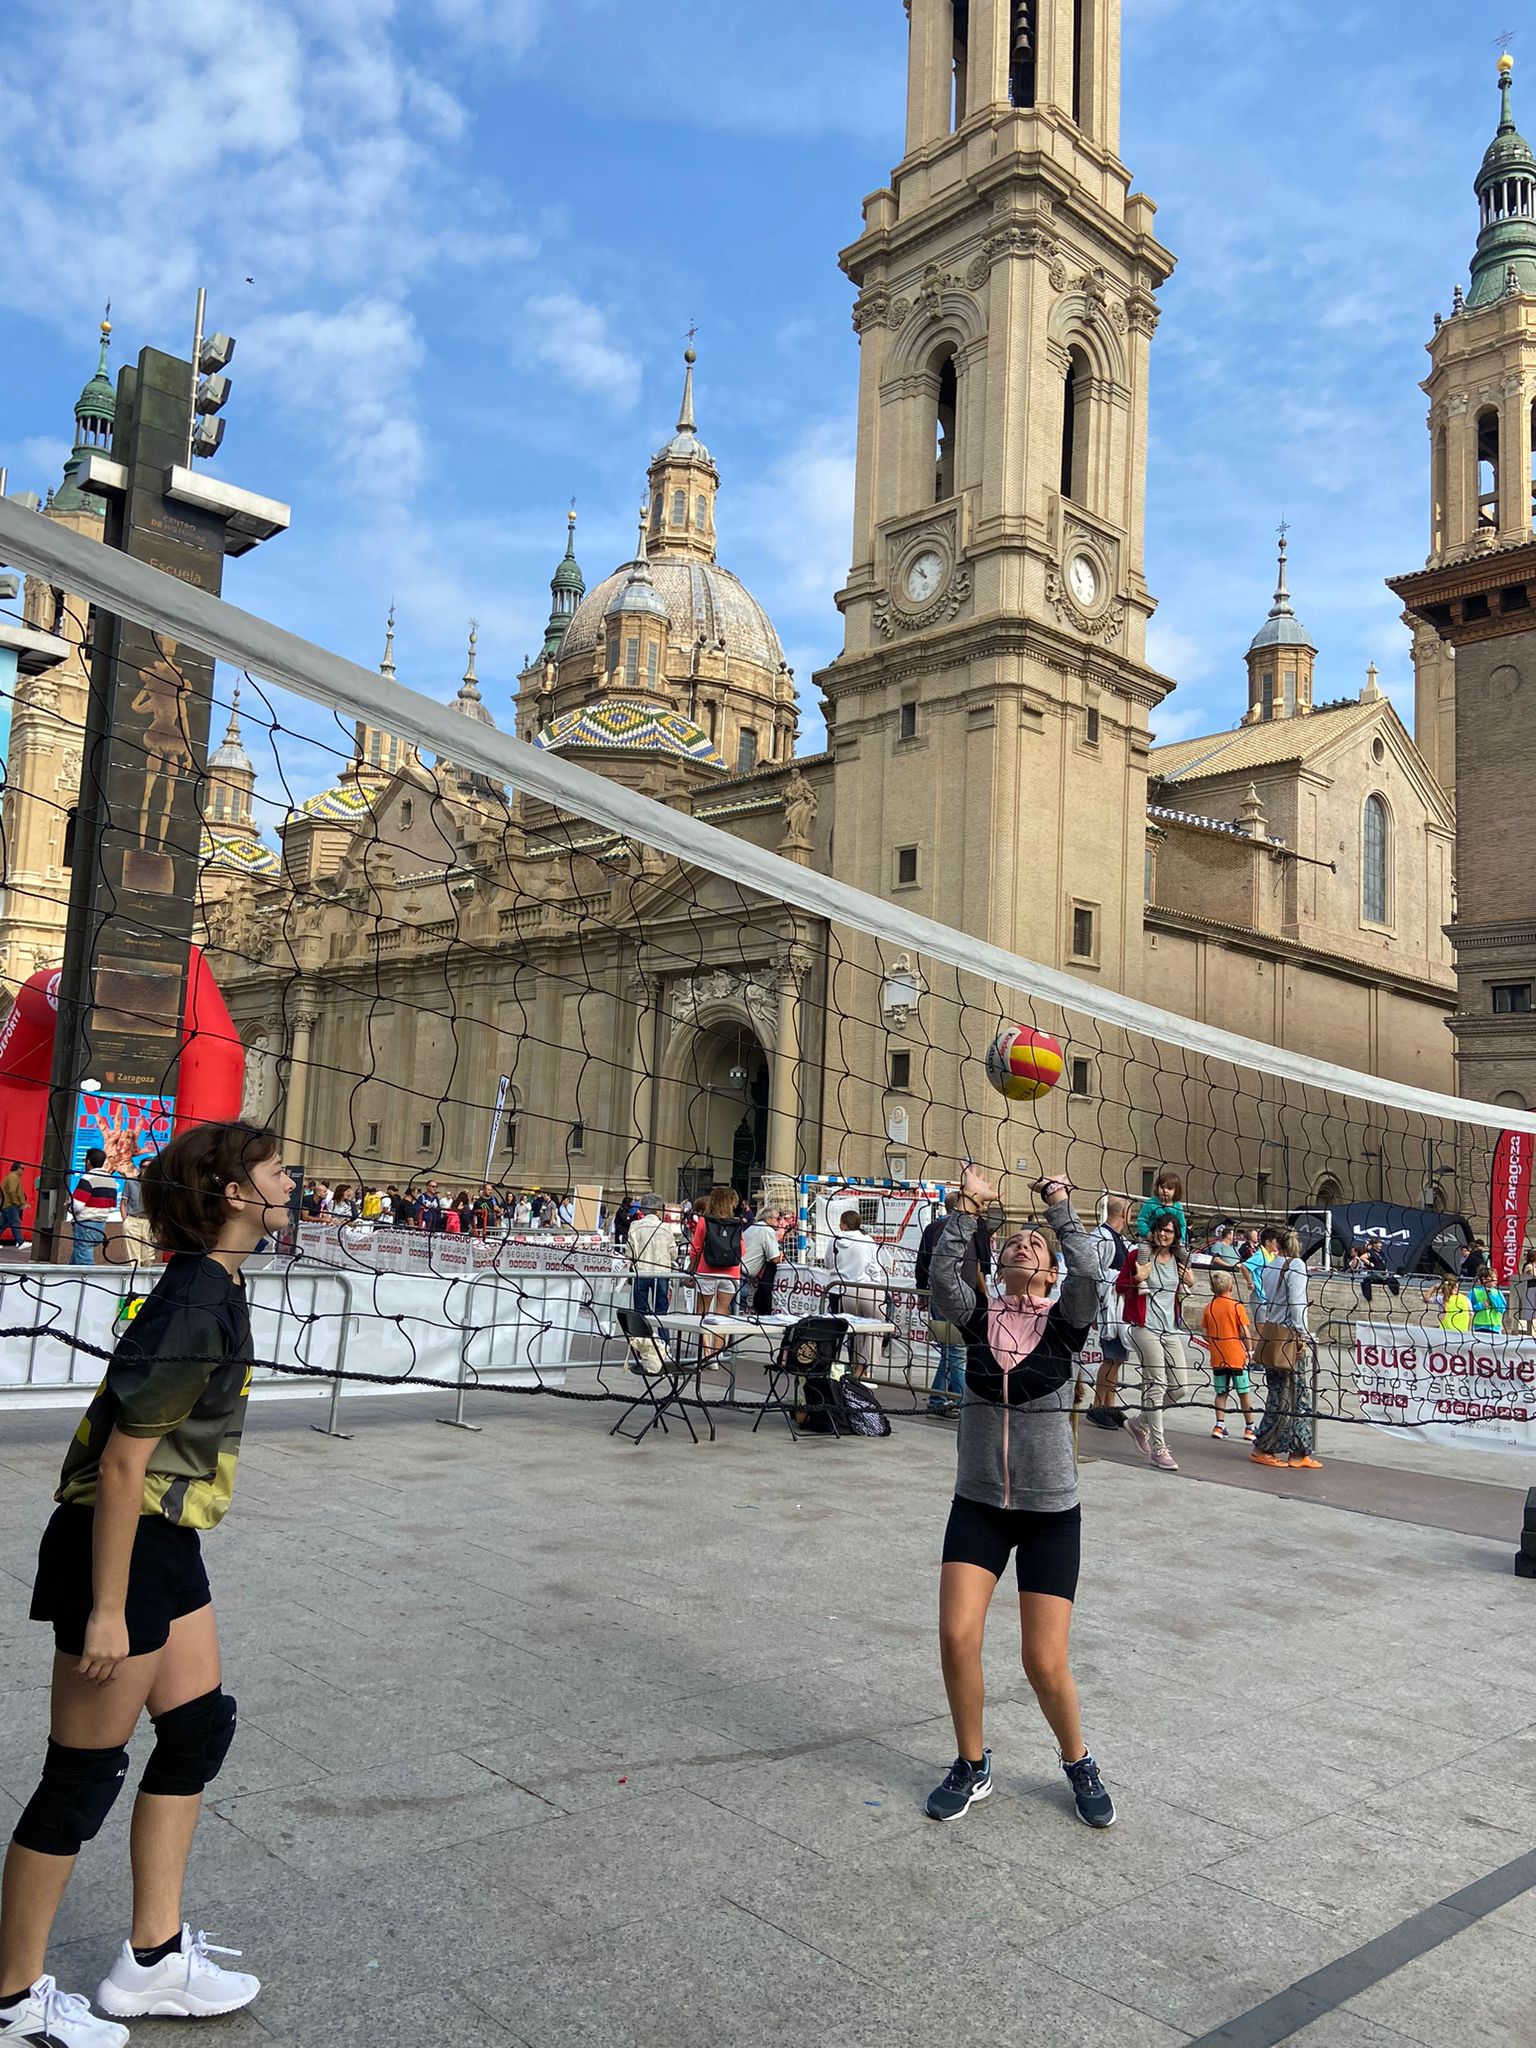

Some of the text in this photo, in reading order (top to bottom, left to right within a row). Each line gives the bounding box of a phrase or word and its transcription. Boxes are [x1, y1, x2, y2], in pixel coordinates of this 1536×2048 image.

[149, 557, 202, 584] Escuela
[117, 1072, 155, 1084] Zaragoza
[82, 1095, 172, 1118] VIVE
[1503, 1135, 1522, 1278] Voleibol Zaragoza
